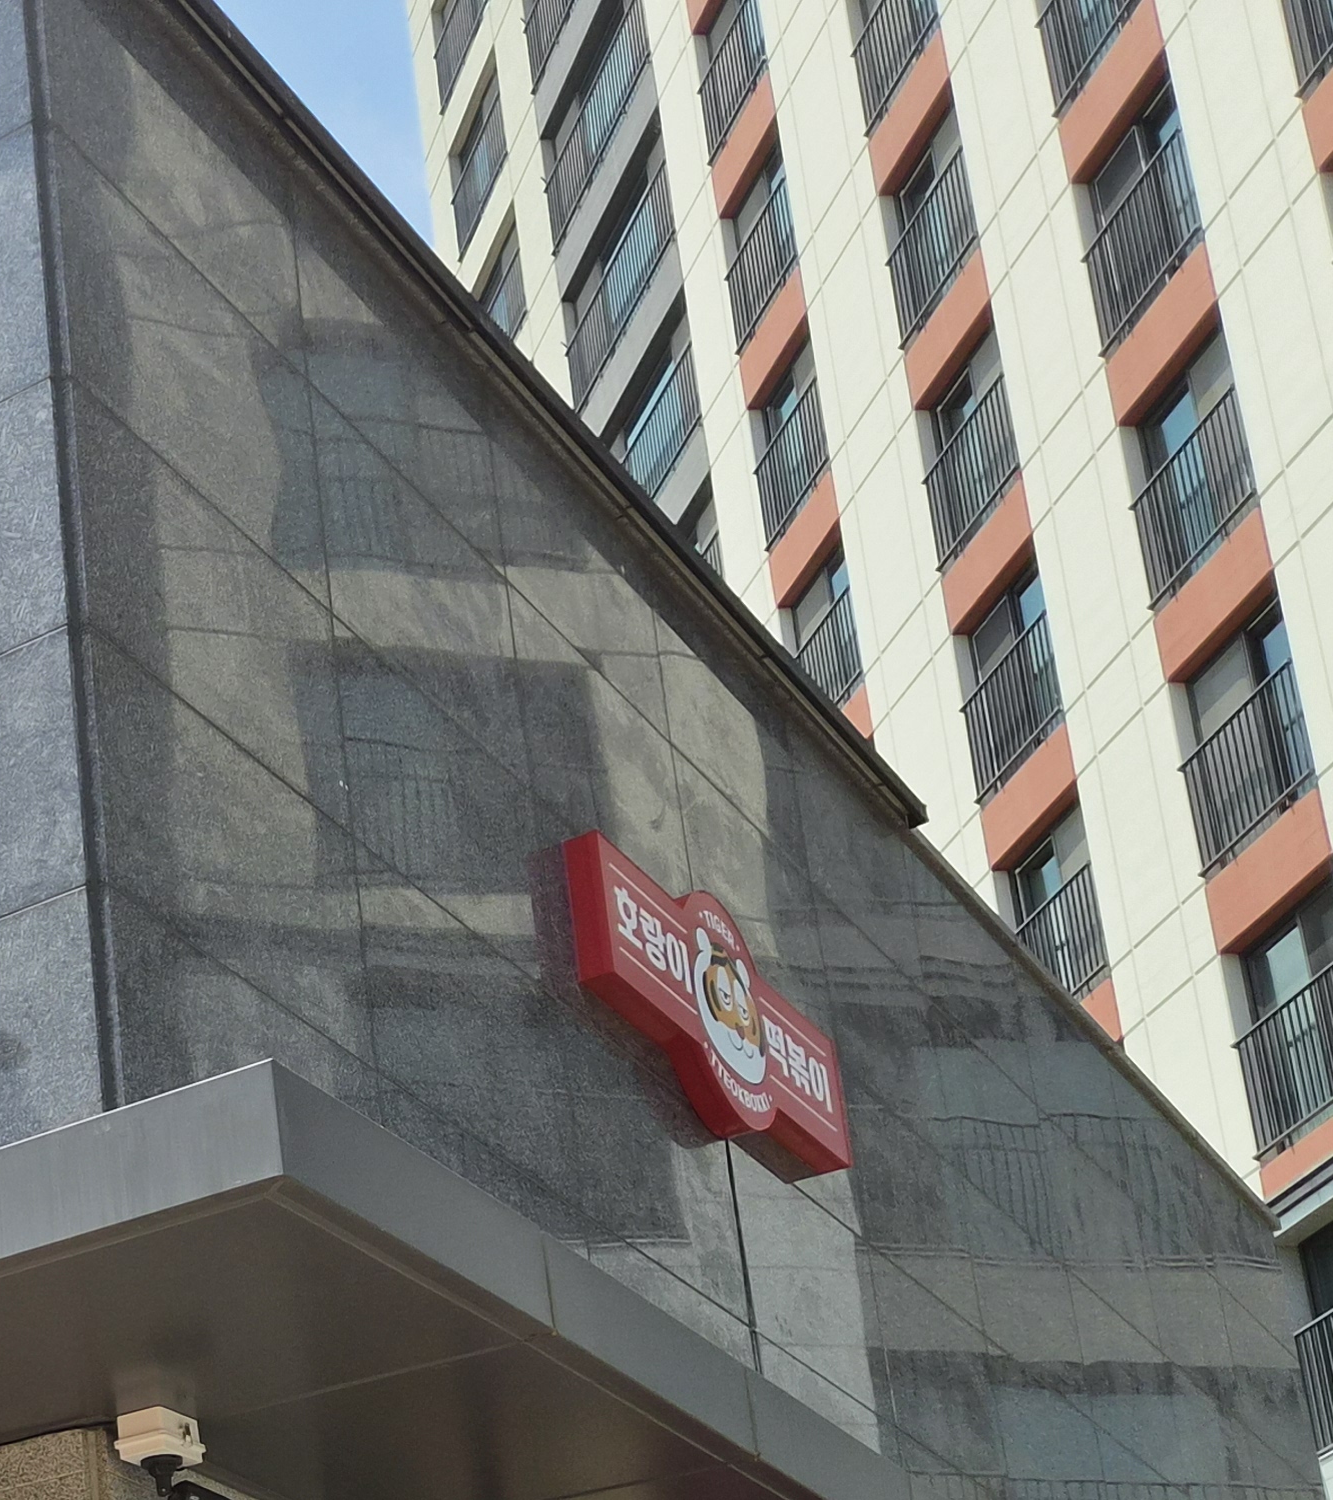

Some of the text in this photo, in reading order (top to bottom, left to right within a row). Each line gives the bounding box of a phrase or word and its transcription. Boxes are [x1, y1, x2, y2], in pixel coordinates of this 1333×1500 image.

[703, 909, 735, 950] TIGER
[613, 885, 833, 1113] 호랑이 떡볶이
